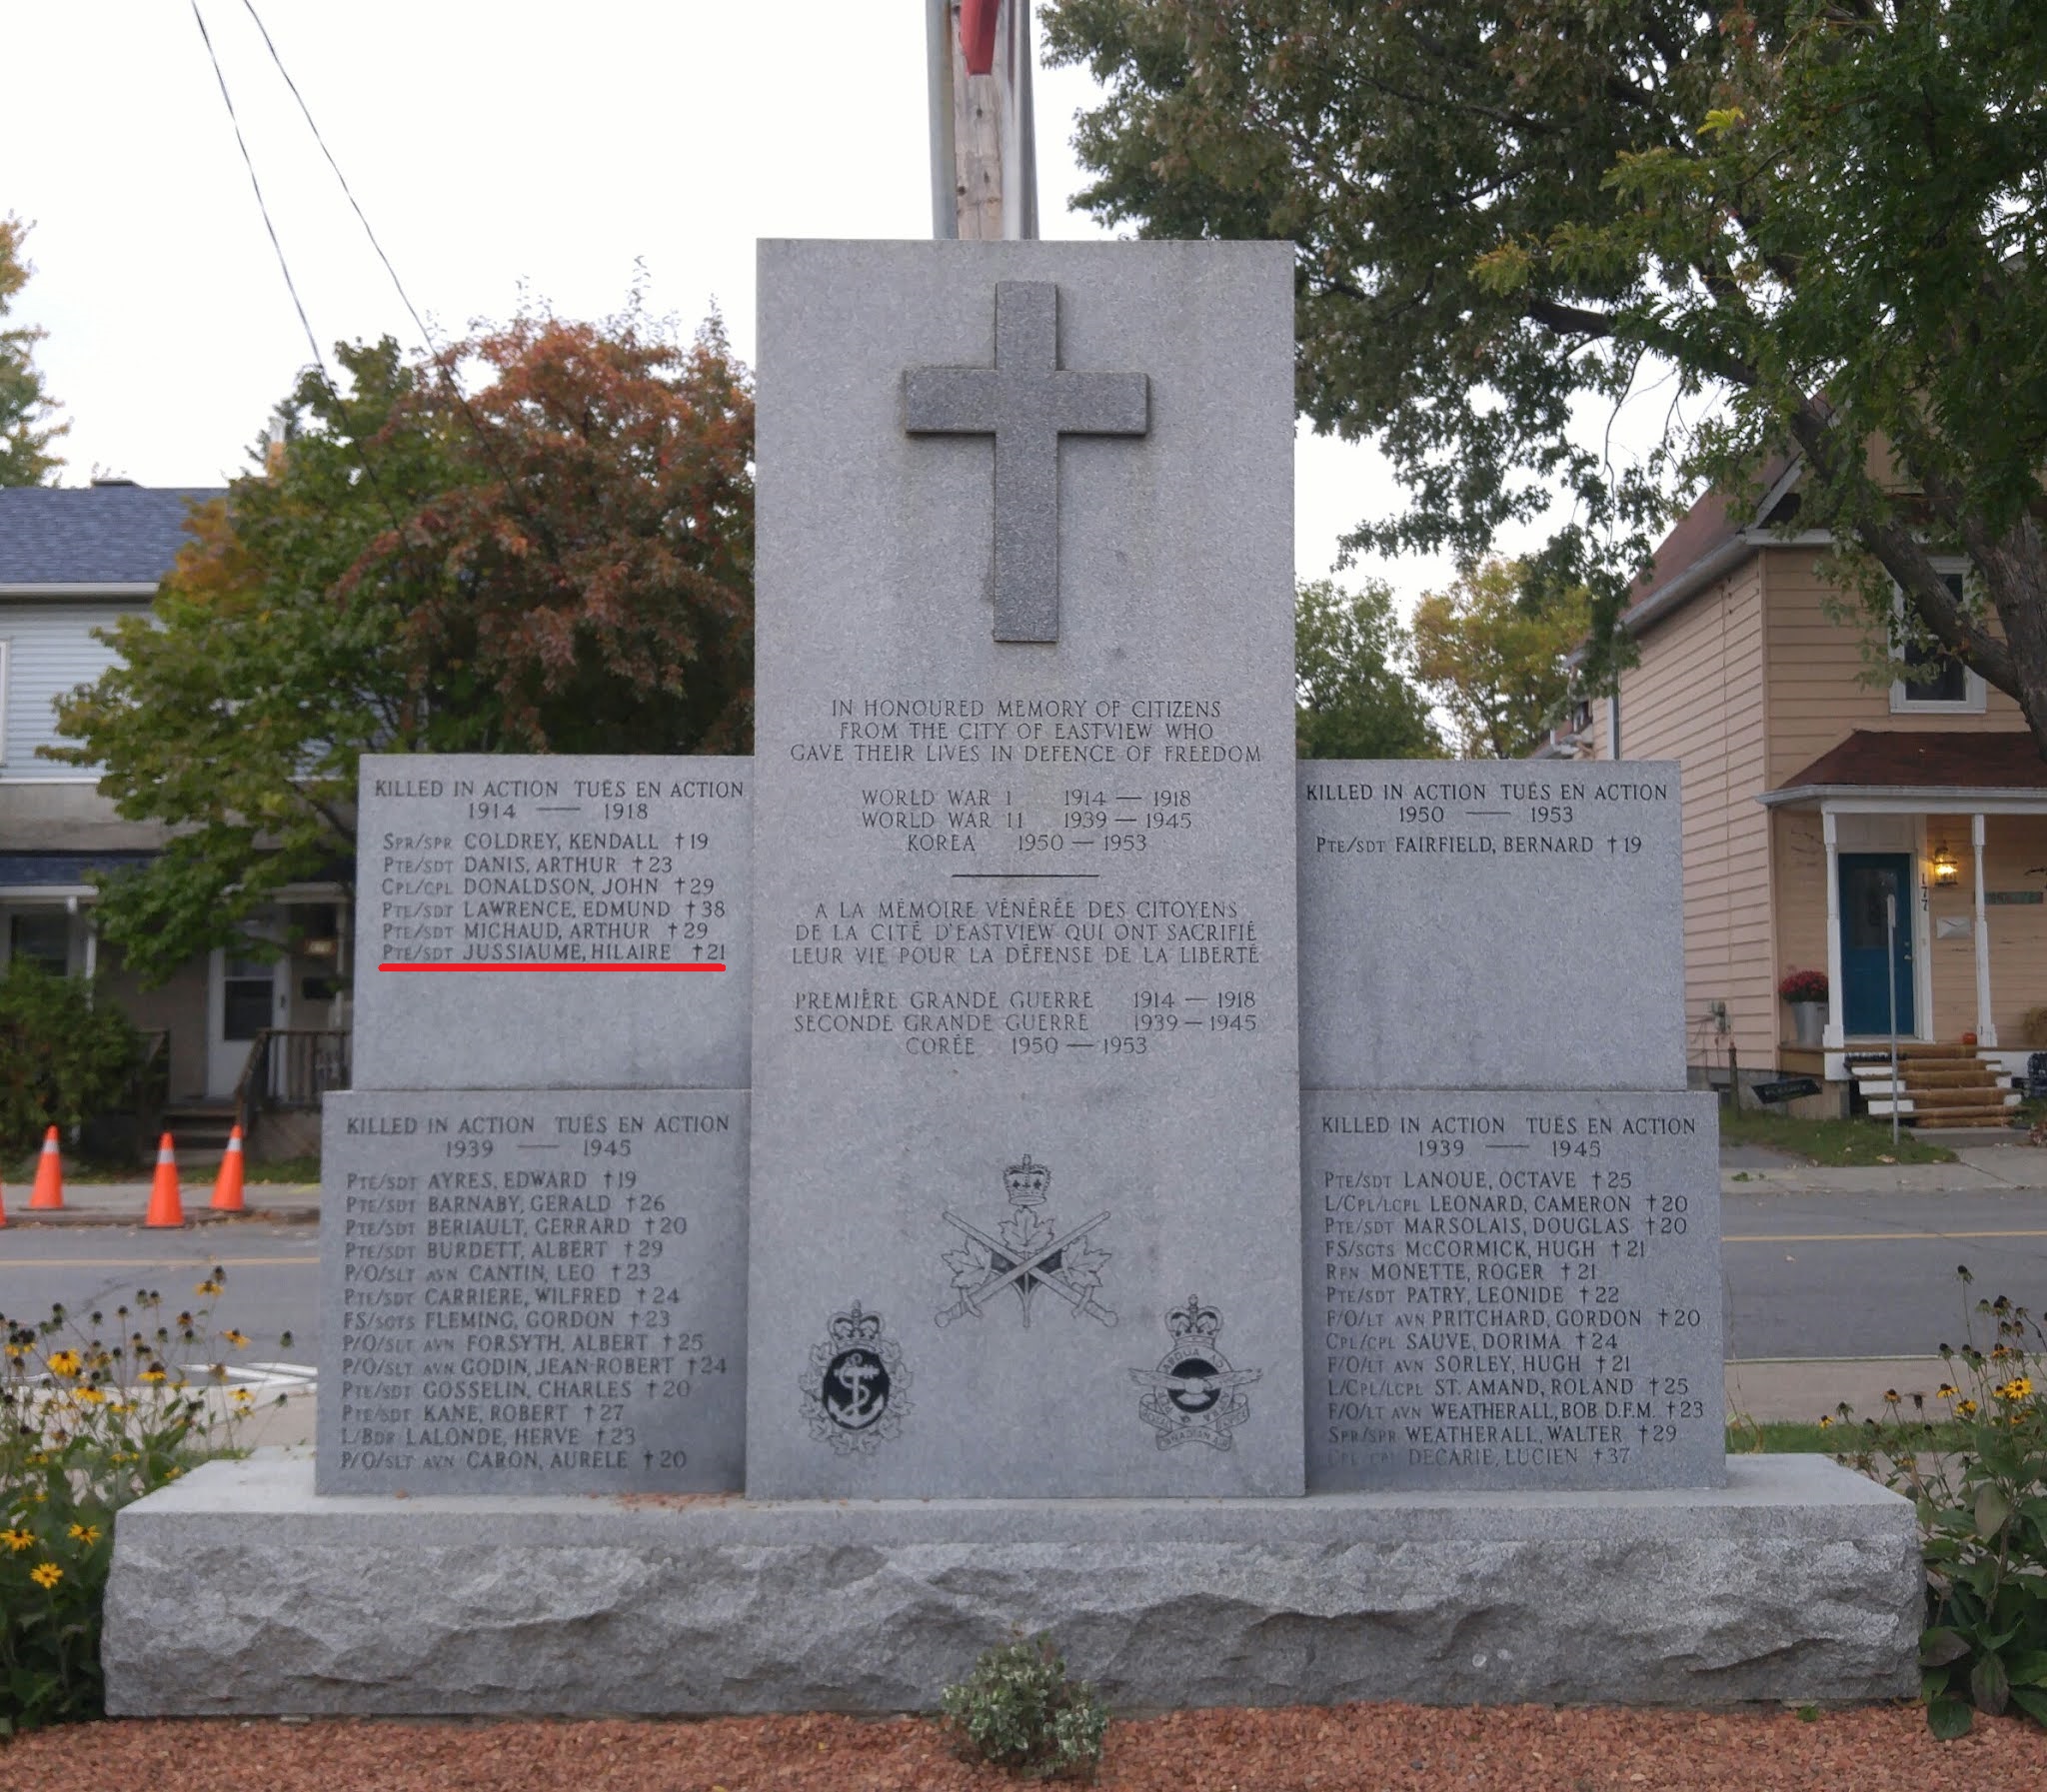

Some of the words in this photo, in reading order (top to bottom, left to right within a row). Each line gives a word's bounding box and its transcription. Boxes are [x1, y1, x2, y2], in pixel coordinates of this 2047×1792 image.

[831, 700, 854, 719] IN
[864, 700, 985, 719] HONOURED
[999, 700, 1087, 719] MEMORY
[1095, 700, 1121, 719] OF
[1131, 700, 1221, 719] CITIZENS
[840, 722, 899, 741] FROM
[909, 722, 948, 741] THE
[958, 722, 1007, 741] CITY
[1017, 722, 1042, 741] OF
[1054, 722, 1153, 741] EASTVIEW
[1164, 722, 1214, 741] WHO
[790, 745, 845, 764] GAVE
[854, 745, 915, 764] THEIR
[926, 745, 980, 764] LIVES
[991, 745, 1013, 764] IN
[1024, 745, 1115, 764] DEFENCE
[1125, 745, 1152, 764] OF
[1164, 745, 1261, 764] FREEDOM
[375, 781, 444, 798] KILLED
[454, 781, 475, 798] IN
[483, 781, 559, 798] ACTION
[636, 781, 662, 798] EN
[670, 781, 744, 798] ACTION
[862, 789, 936, 808] WORLD
[948, 789, 991, 808] WAR
[1063, 789, 1106, 808] 1914
[1152, 789, 1191, 808] 1918
[1306, 784, 1373, 801] KILLED
[1383, 784, 1403, 801] IN
[1412, 784, 1486, 801] ACTION
[1560, 784, 1585, 801] EN
[1594, 784, 1668, 801] ACTION
[468, 803, 517, 821] 1914
[604, 803, 649, 821] 1918
[862, 812, 936, 830] WORLD
[948, 812, 991, 830] WAR
[1063, 812, 1107, 830] 1939
[1145, 812, 1192, 830] 1945
[1398, 806, 1445, 824] 1950
[1530, 806, 1574, 824] 1953
[569, 832, 659, 850] KENDALL
[908, 835, 977, 853] KOREA
[1018, 835, 1063, 853] 1950
[1103, 835, 1147, 853] 1953
[1503, 836, 1594, 854] BERNARD
[536, 856, 617, 873] ARTHUR
[601, 878, 659, 895] JOHN
[583, 900, 671, 917] EDMUND
[815, 902, 829, 919] A
[840, 902, 865, 919] LA
[1087, 902, 1125, 919] DES
[1135, 902, 1238, 919] CITOYENS
[569, 921, 650, 939] ARTHUR
[795, 924, 822, 942] DE
[833, 924, 858, 942] LA
[1064, 924, 1104, 942] QUI
[1113, 924, 1155, 942] ONT
[591, 942, 672, 960] HILAIRE
[792, 946, 844, 964] LEUR
[854, 946, 887, 964] VIE
[899, 946, 958, 964] POUR
[969, 946, 995, 964] LA
[1104, 946, 1131, 964] DE
[1142, 946, 1167, 964] LA
[910, 991, 1000, 1009] GRANDE
[1009, 991, 1094, 1009] GUERRE
[1132, 991, 1175, 1009] 1914
[1216, 991, 1256, 1009] 1918
[794, 1012, 894, 1032] SECONDE
[903, 1012, 993, 1032] GRANDE
[1005, 1012, 1089, 1032] GUERRE
[1134, 1012, 1178, 1032] 1939
[1209, 1012, 1257, 1032] 1945
[1011, 1036, 1058, 1055] 1950
[1102, 1036, 1147, 1055] 1953
[346, 1116, 418, 1135] KILLED
[428, 1116, 449, 1135] IN
[457, 1116, 535, 1135] ACTION
[618, 1116, 644, 1135] EN
[654, 1116, 730, 1135] ACTION
[1321, 1117, 1390, 1135] KILLED
[1399, 1117, 1421, 1135] IN
[1430, 1117, 1506, 1135] ACTION
[1587, 1117, 1612, 1135] EN
[1622, 1117, 1696, 1135] ACTION
[446, 1139, 494, 1159] 1939
[583, 1139, 632, 1159] 1945
[1417, 1138, 1465, 1158] 1939
[1551, 1138, 1601, 1158] 1945
[503, 1171, 587, 1188] EDWARD
[1498, 1171, 1576, 1189] OCTAVE
[530, 1194, 612, 1213] GERALD
[1533, 1195, 1631, 1213] CAMERON
[534, 1217, 631, 1236] GERRARD
[1532, 1217, 1630, 1235] DOUGLAS
[530, 1240, 609, 1258] ALBERT
[1537, 1240, 1596, 1258] HUGH
[557, 1263, 595, 1282] LEO
[1477, 1263, 1544, 1282] ROGER
[536, 1286, 622, 1307] WILFRED
[1476, 1286, 1564, 1305] LEONIDE
[1555, 1309, 1642, 1327] GORDON
[572, 1333, 649, 1351] ALBERT
[1482, 1332, 1561, 1350] DORIMA
[1522, 1355, 1581, 1373] HUGH
[538, 1380, 633, 1398] CHARLES
[1550, 1378, 1634, 1396] ROLAND
[490, 1403, 569, 1422] ROBERT
[1560, 1401, 1598, 1421] BOB
[1547, 1425, 1623, 1444] WALTER
